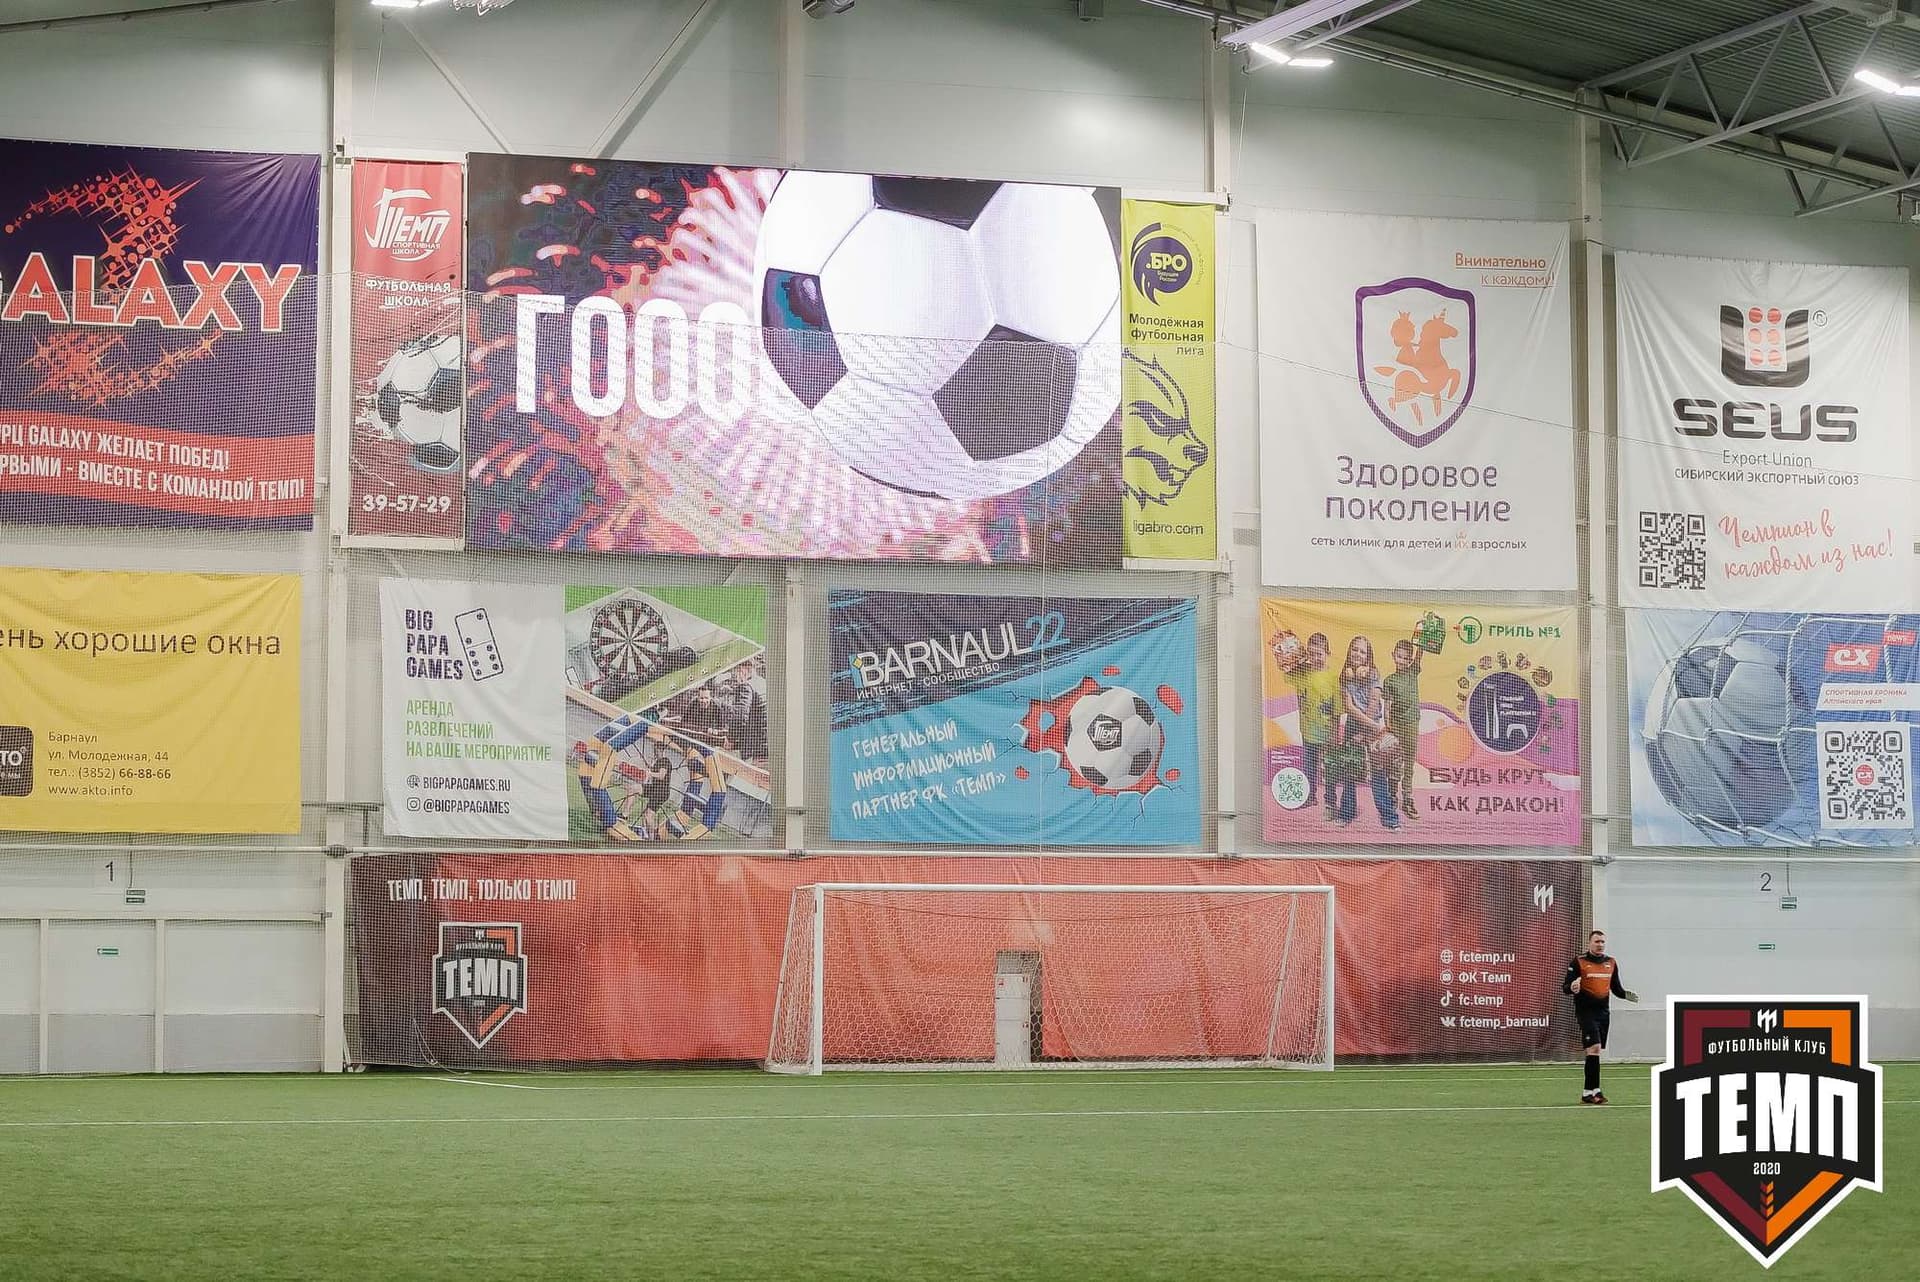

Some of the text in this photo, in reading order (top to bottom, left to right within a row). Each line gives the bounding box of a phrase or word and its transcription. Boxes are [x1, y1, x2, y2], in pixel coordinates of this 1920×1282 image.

[1455, 252, 1546, 269] Внимательно
[365, 280, 451, 293] ФУТБОЛЬНАЯ
[1481, 272, 1555, 287] к каждому!
[0, 252, 301, 332] ALAXY
[384, 296, 431, 307] ШКОЛА
[1129, 313, 1204, 329] Молодёжная
[1131, 327, 1204, 342] футбольная
[1176, 346, 1204, 356] лига
[1673, 398, 1859, 443] SEUS
[0, 424, 230, 472] РЦ GALAXY ЖЕЛАЕТ ПОБЕД!
[1722, 449, 1813, 468] Export Union
[1337, 455, 1498, 489] Здоровое
[1674, 467, 1860, 487] СИБИРСКИЙ ЭКСПОРТНЫЙ СОЮЗ
[78, 461, 142, 490] ВМЕСТЕ
[148, 471, 158, 491] С
[162, 474, 254, 503] КОМАНДОЙ
[258, 479, 305, 501] ТЕМП!
[362, 494, 451, 513] 39-57-29
[1325, 496, 1511, 522] поколение
[1718, 514, 1818, 548] Чемпион
[1311, 536, 1336, 547] сеть
[1338, 537, 1381, 548] клиник
[1383, 539, 1405, 549] для
[1407, 538, 1442, 549] детей
[1444, 541, 1452, 549] и
[1471, 541, 1528, 552] взрослых
[1724, 529, 1895, 580] каждом из нас!
[405, 609, 433, 630] BIG
[1489, 625, 1534, 637] ГРИЛЬ
[53, 630, 197, 658] хорошие
[207, 634, 281, 655] окна
[407, 633, 449, 656] PAPA
[406, 656, 464, 680] GAMES
[923, 662, 1000, 687] СООБЩЕСТВО
[406, 700, 454, 717] АРЕНДА
[48, 731, 98, 744] Барнаул
[406, 720, 494, 739] РАЗВЛЕЧЕНИЙ
[852, 719, 958, 758] ГЕНЕРАЛЬНЫЙ
[48, 750, 169, 763] ул. Молодежная, 44
[406, 741, 551, 761] НА ВАШЕ МЕРОПРИЯТИЕ
[78, 767, 116, 780] (3852)
[119, 768, 171, 779] 66-88-66
[852, 739, 996, 790] ИНФОРМАЦИОННЫЙ
[423, 777, 511, 791] BIGPAPAGAMES.RU
[1429, 767, 1492, 786] БУДЬ
[48, 785, 133, 796] www.akto.info
[851, 771, 1007, 820] ПАРТНЕР ФК «ТЕМП»
[423, 798, 510, 814] @BIGPAPAGAMES
[1430, 796, 1564, 815] КАК ДРАКОН!
[105, 861, 113, 881] 1
[387, 879, 577, 902] ТЕМП, ТЕМП, ТОЛЬКО ТЕМП!
[1760, 872, 1772, 892] 2
[1459, 950, 1515, 965] fctemp.ru
[442, 958, 518, 1000] ТЕМП
[1458, 972, 1511, 983] ФК Темп
[1458, 993, 1504, 1007] fc.temp
[1460, 1015, 1549, 1029] fctemp_barnaul
